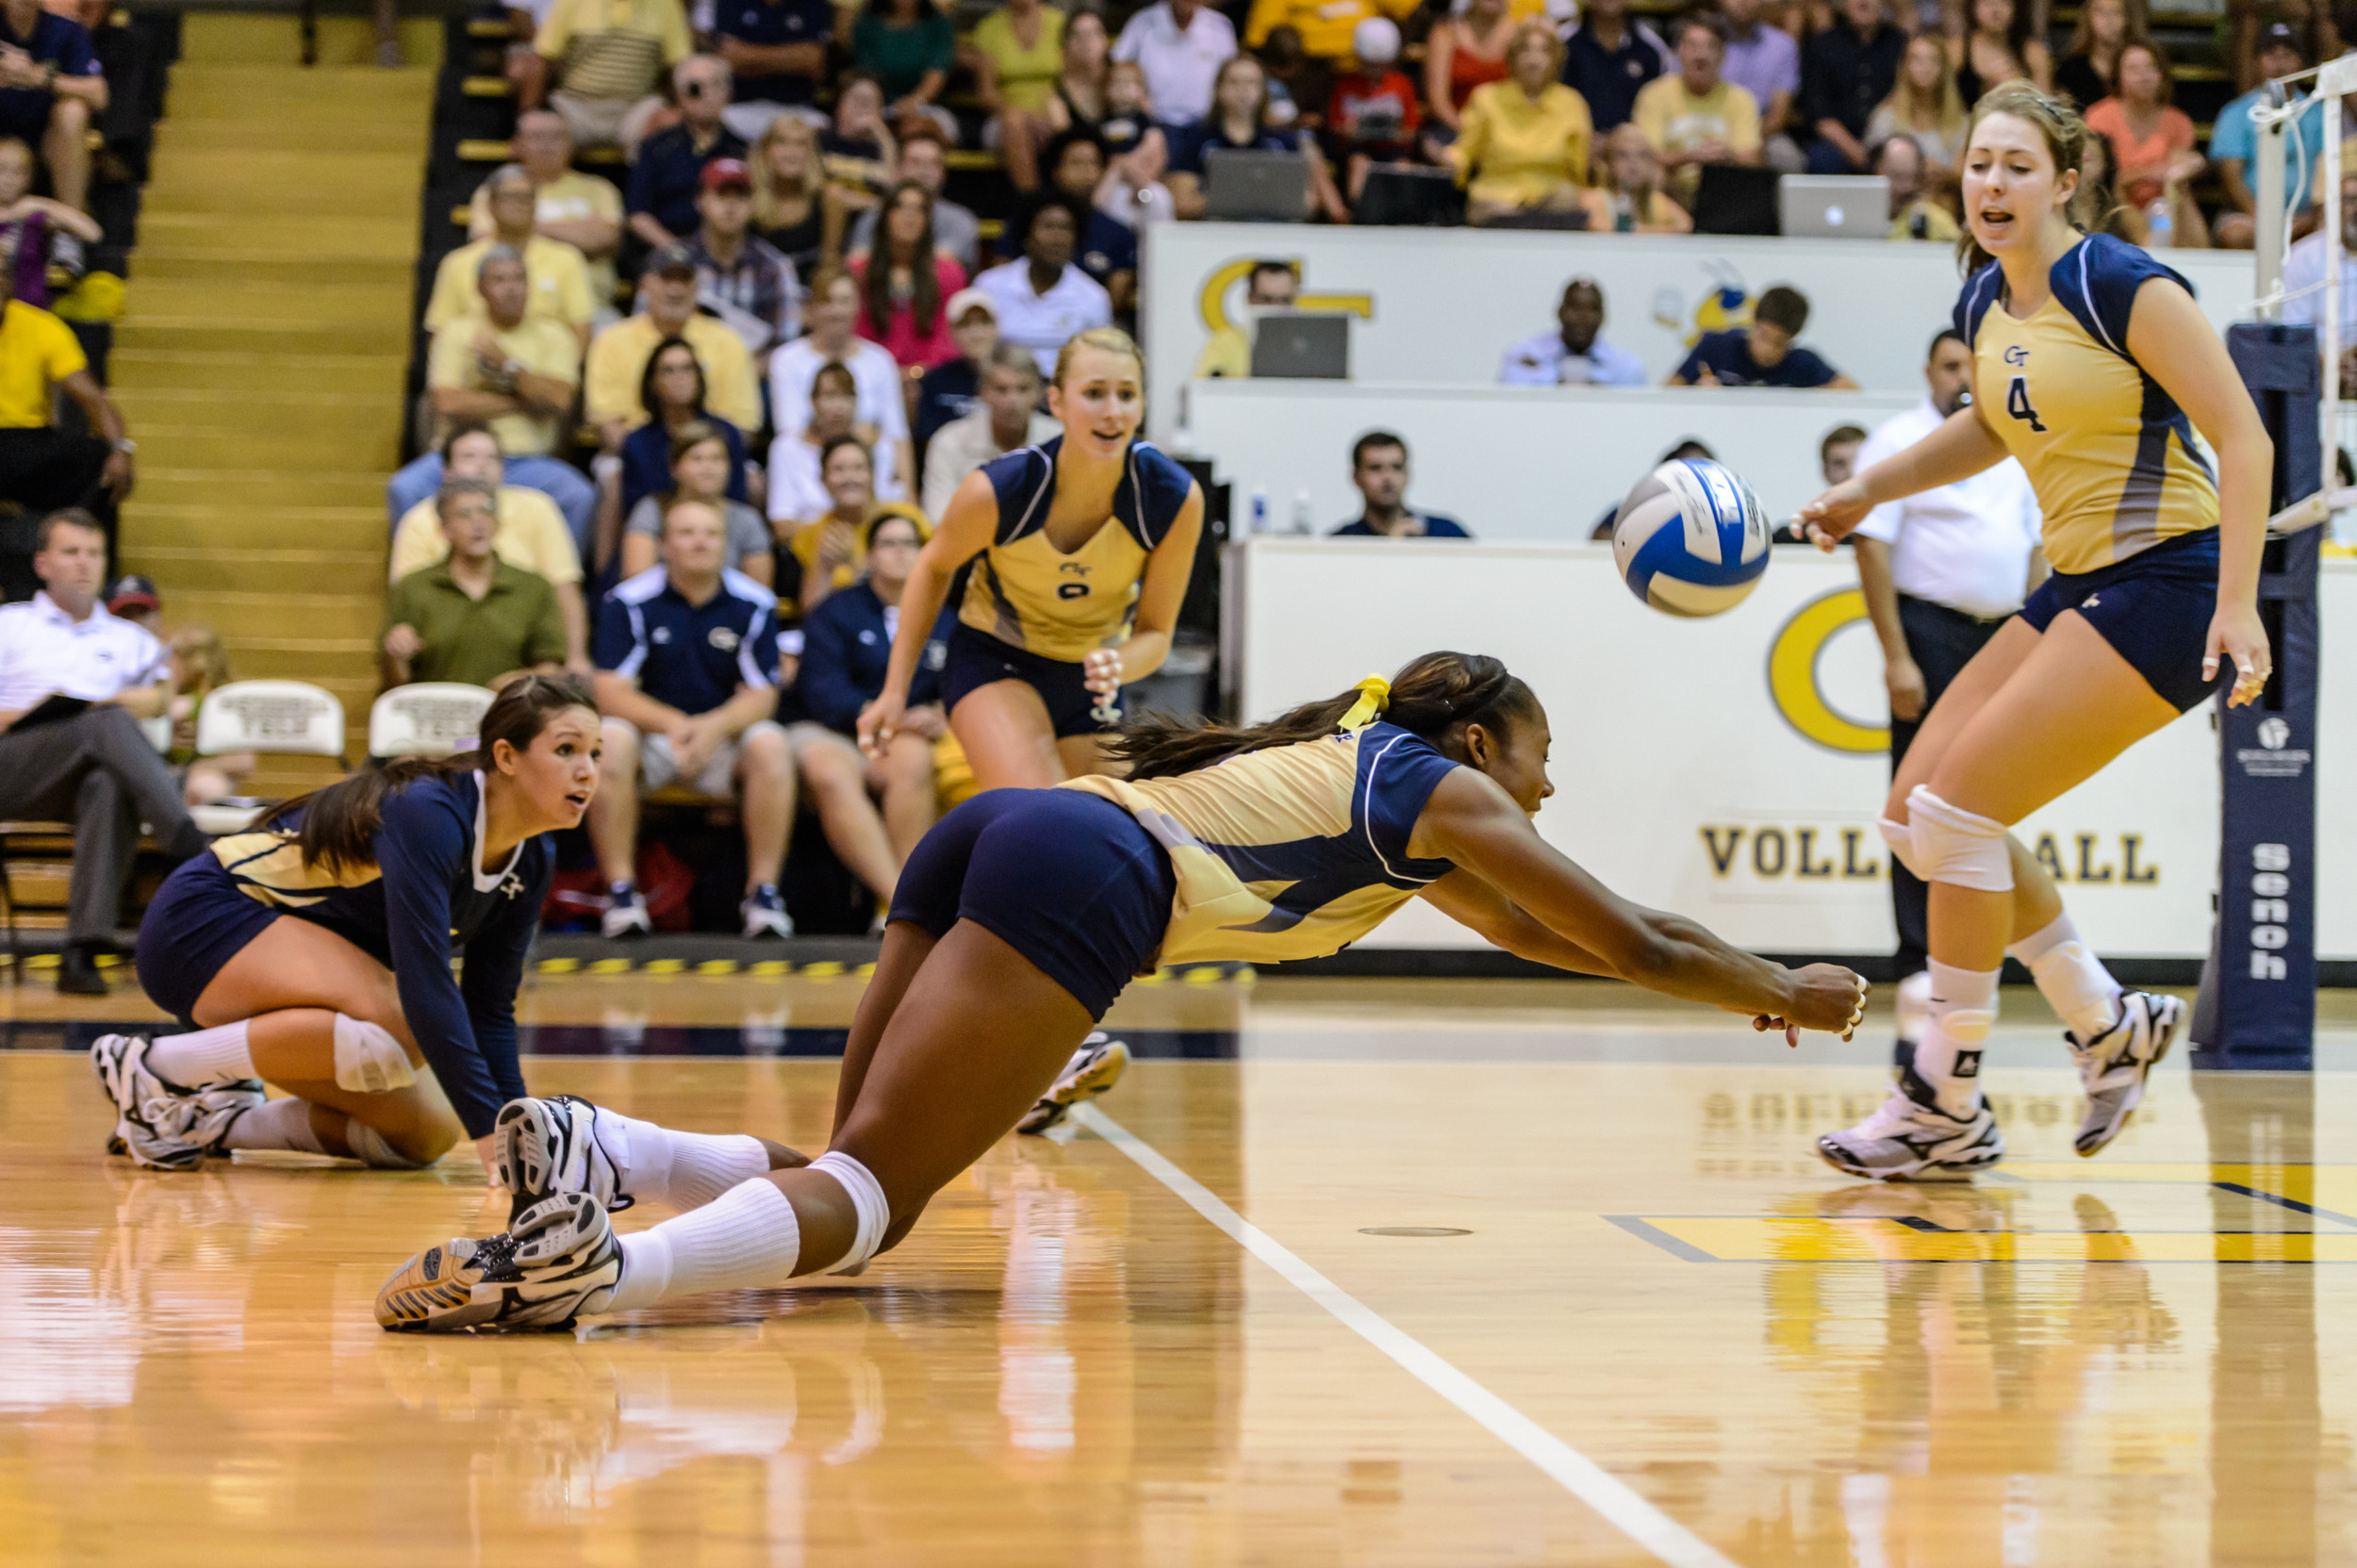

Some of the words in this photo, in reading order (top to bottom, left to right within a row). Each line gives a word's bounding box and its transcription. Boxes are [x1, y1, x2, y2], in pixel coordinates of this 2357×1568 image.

[2004, 345, 2030, 367] GT
[2007, 375, 2049, 433] 4
[1699, 826, 2161, 883] VOLLALL
